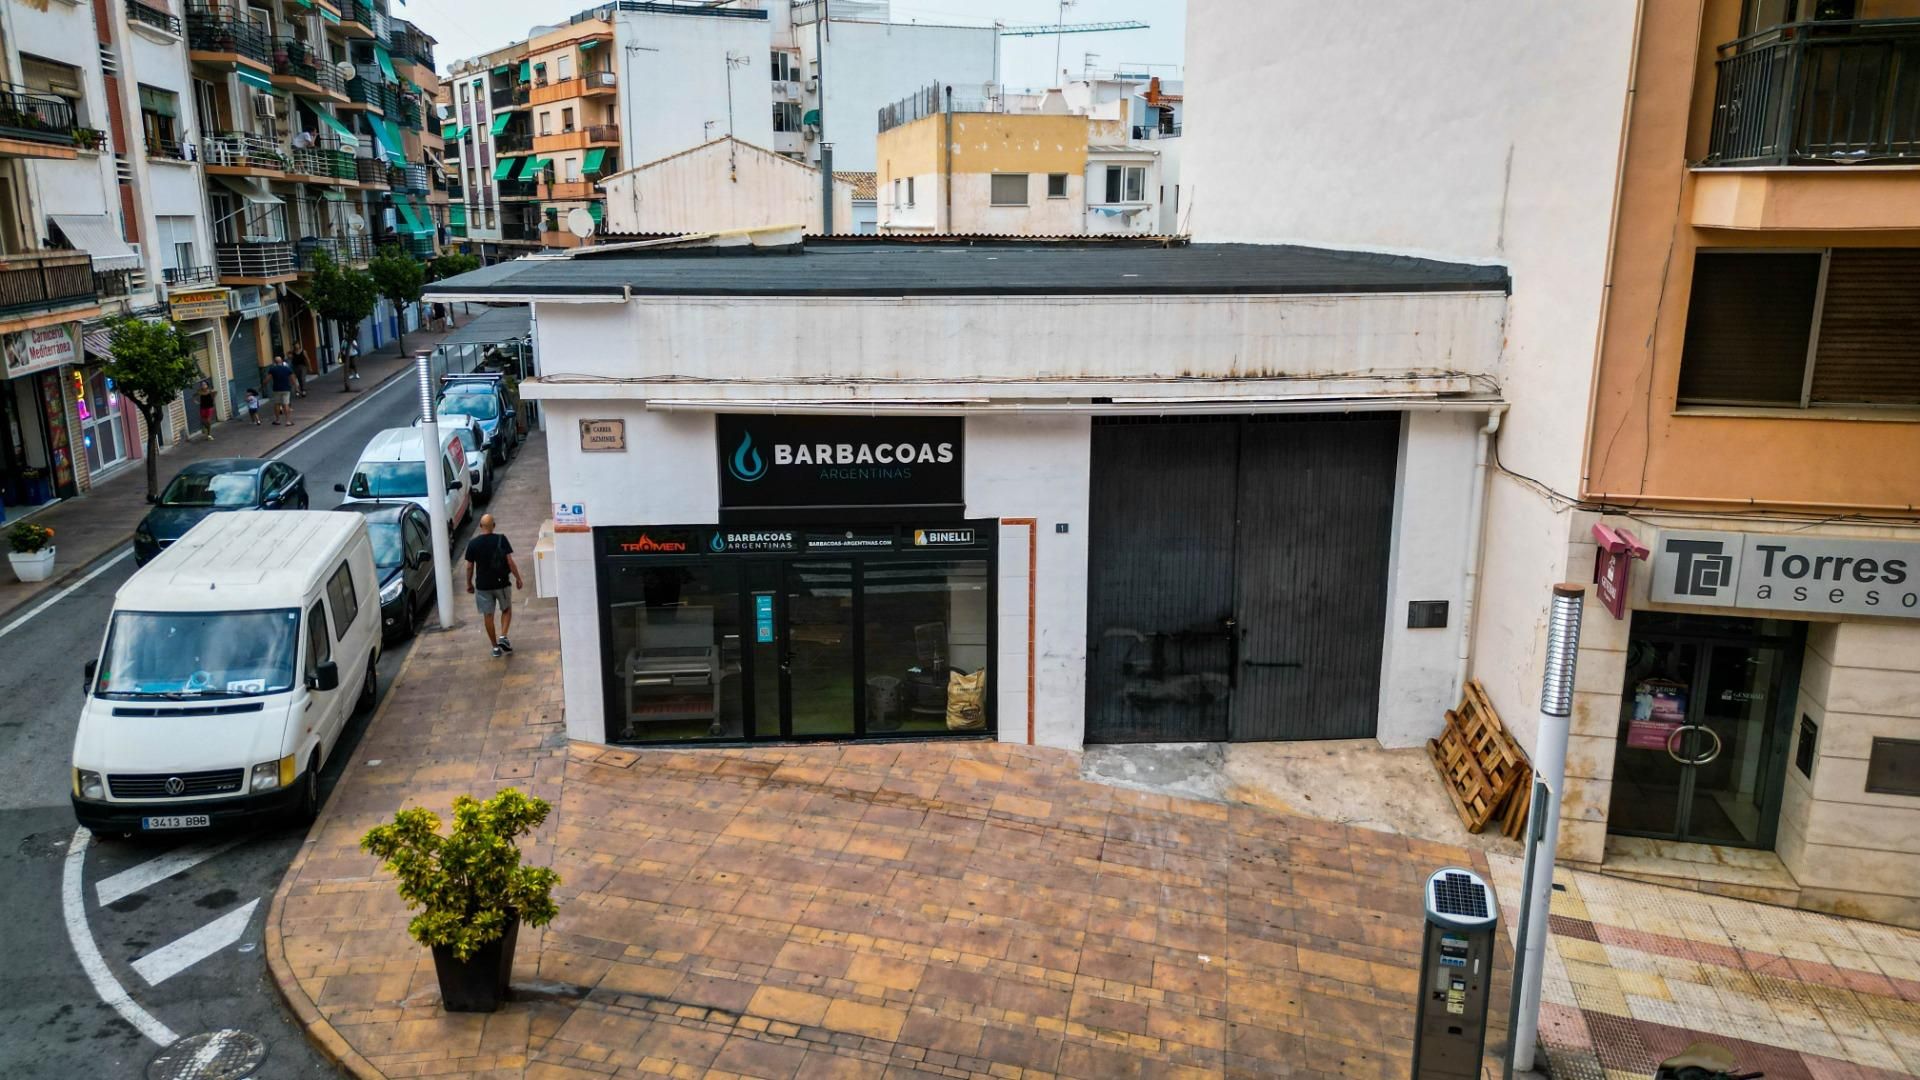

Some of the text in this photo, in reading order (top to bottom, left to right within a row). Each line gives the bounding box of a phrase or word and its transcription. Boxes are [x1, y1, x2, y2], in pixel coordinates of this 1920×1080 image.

[774, 443, 954, 465] BARBACOAS
[820, 468, 912, 480] ARGENTINAS
[727, 533, 792, 542] BARBACOAS
[929, 532, 970, 542] BINELLI
[727, 542, 793, 550] ARGENTINAS
[1756, 545, 1908, 585] Torres
[1756, 584, 1918, 608] aseso
[151, 816, 208, 828] 3413 BBB
